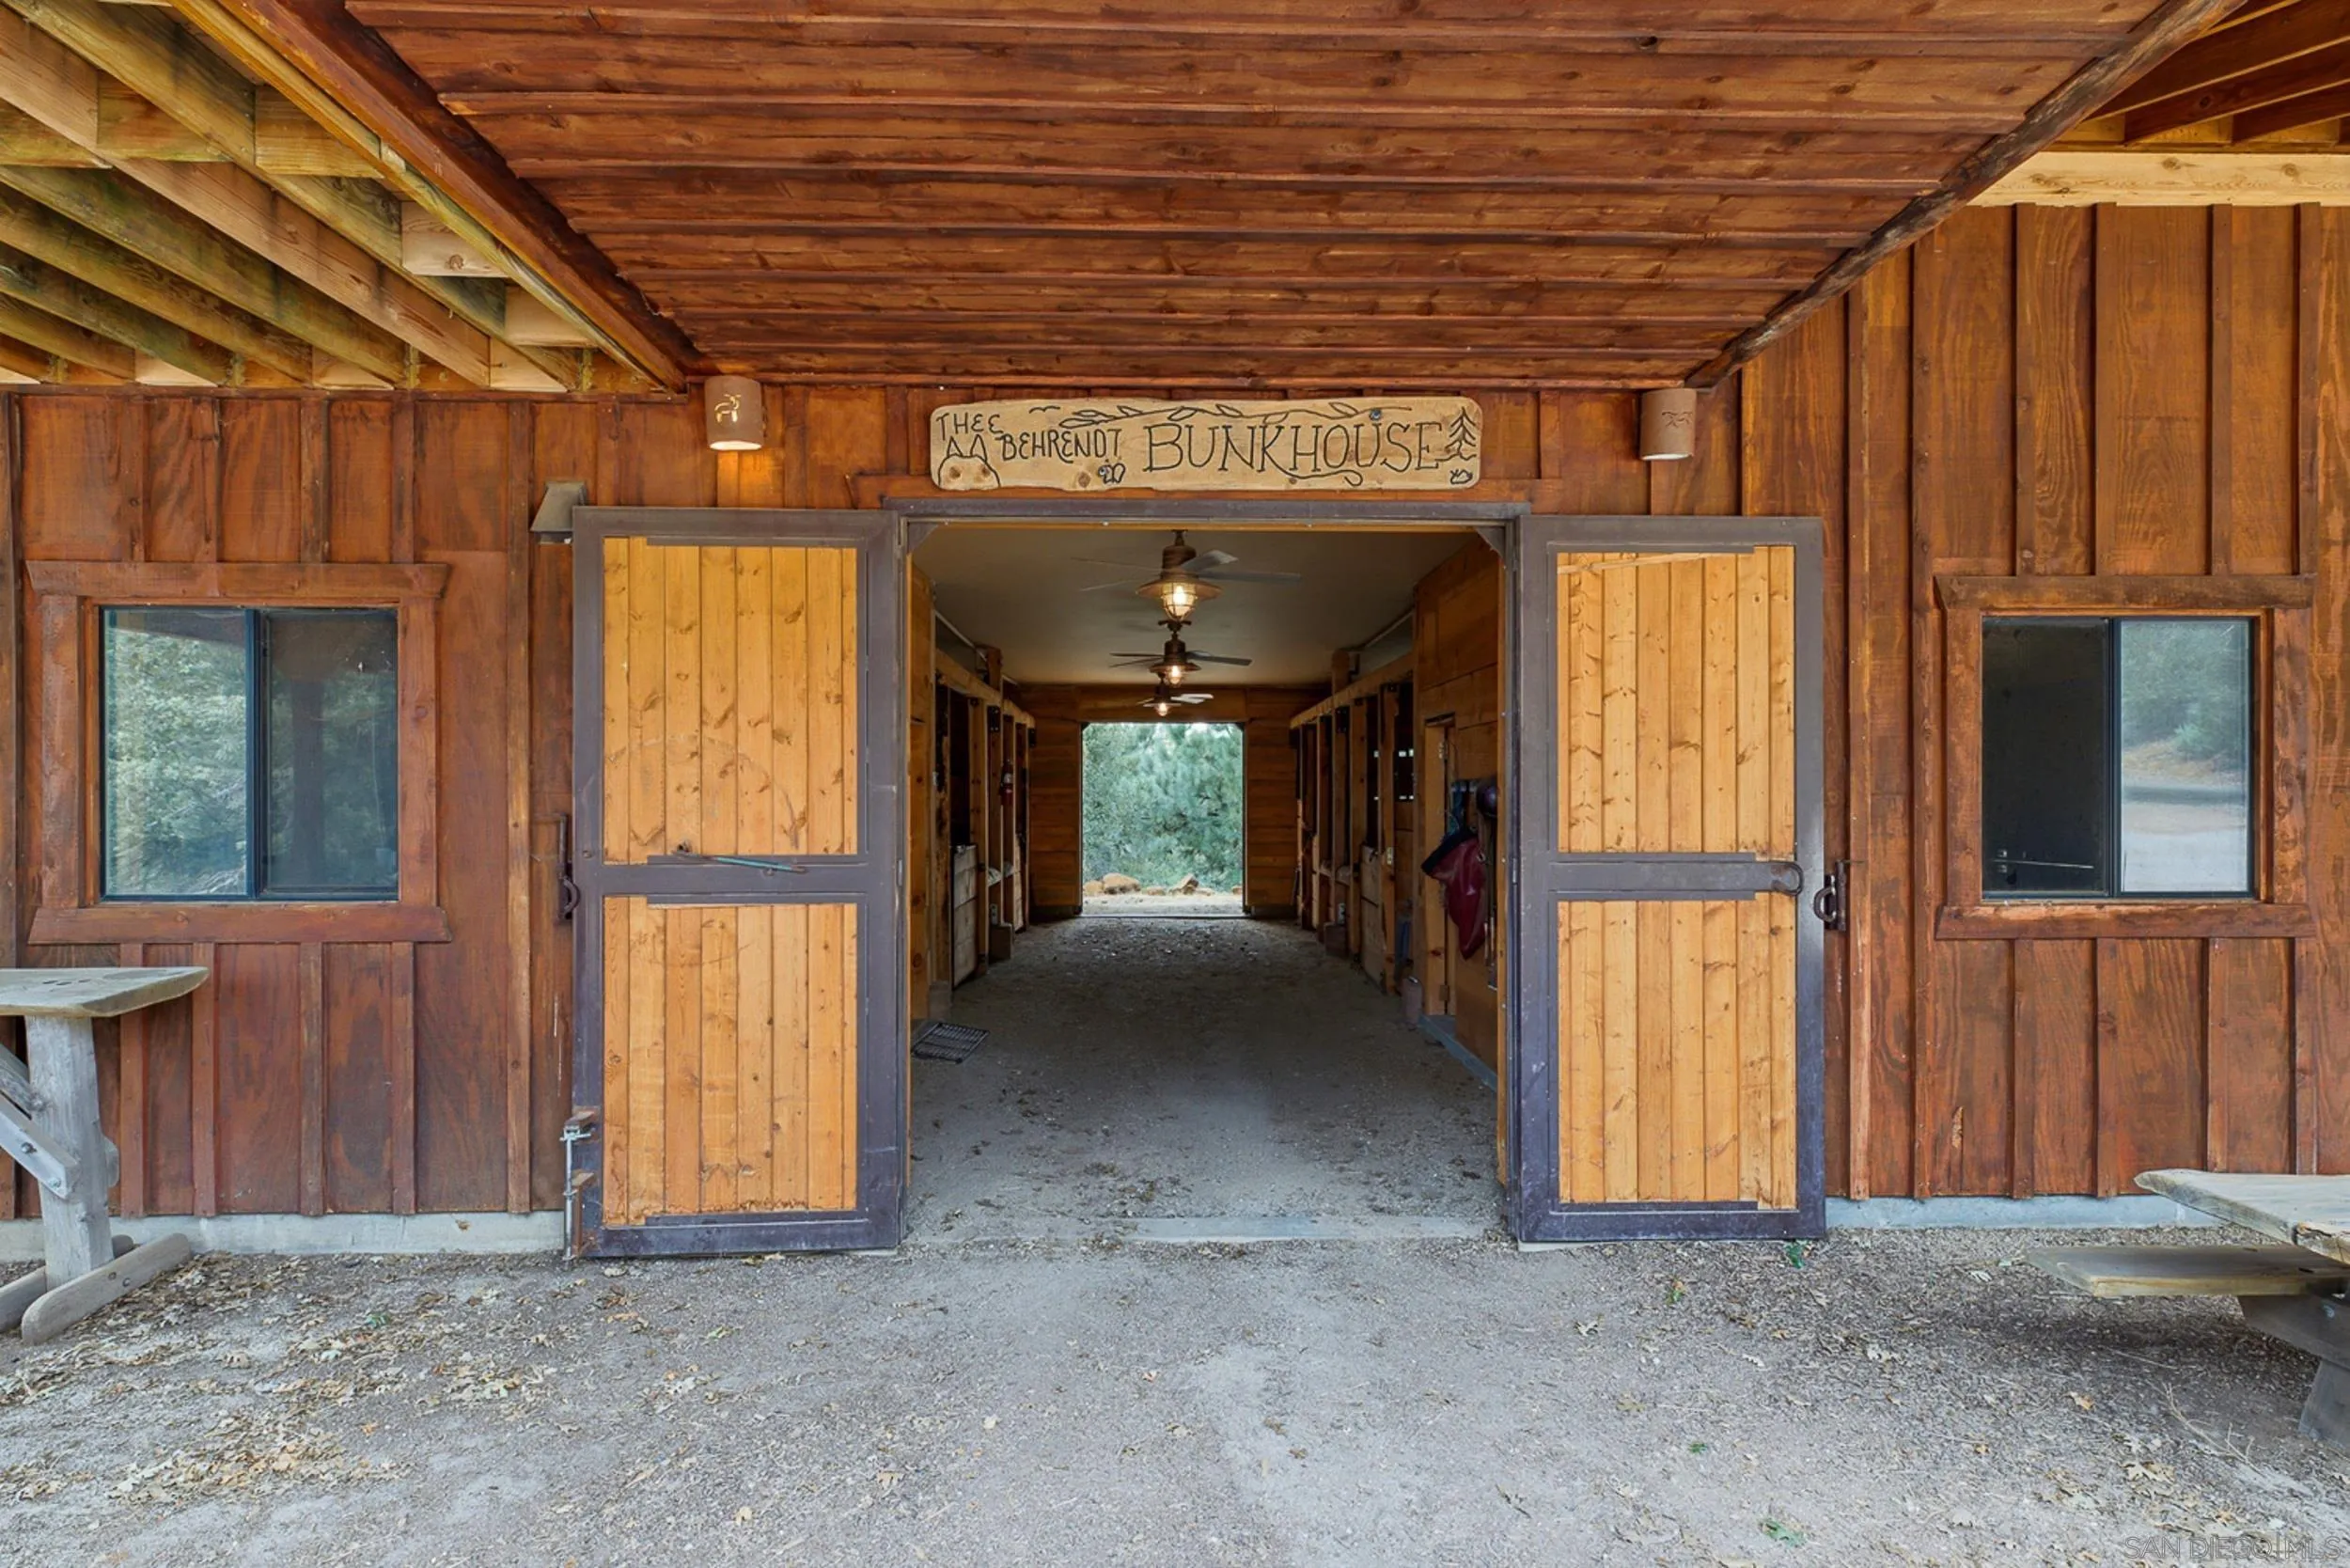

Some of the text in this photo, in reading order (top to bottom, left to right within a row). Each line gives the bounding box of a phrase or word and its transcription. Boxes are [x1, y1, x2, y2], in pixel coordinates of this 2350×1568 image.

[935, 411, 1003, 441] THEE
[997, 422, 1443, 486] BEHRENDT BUNKHOUSE
